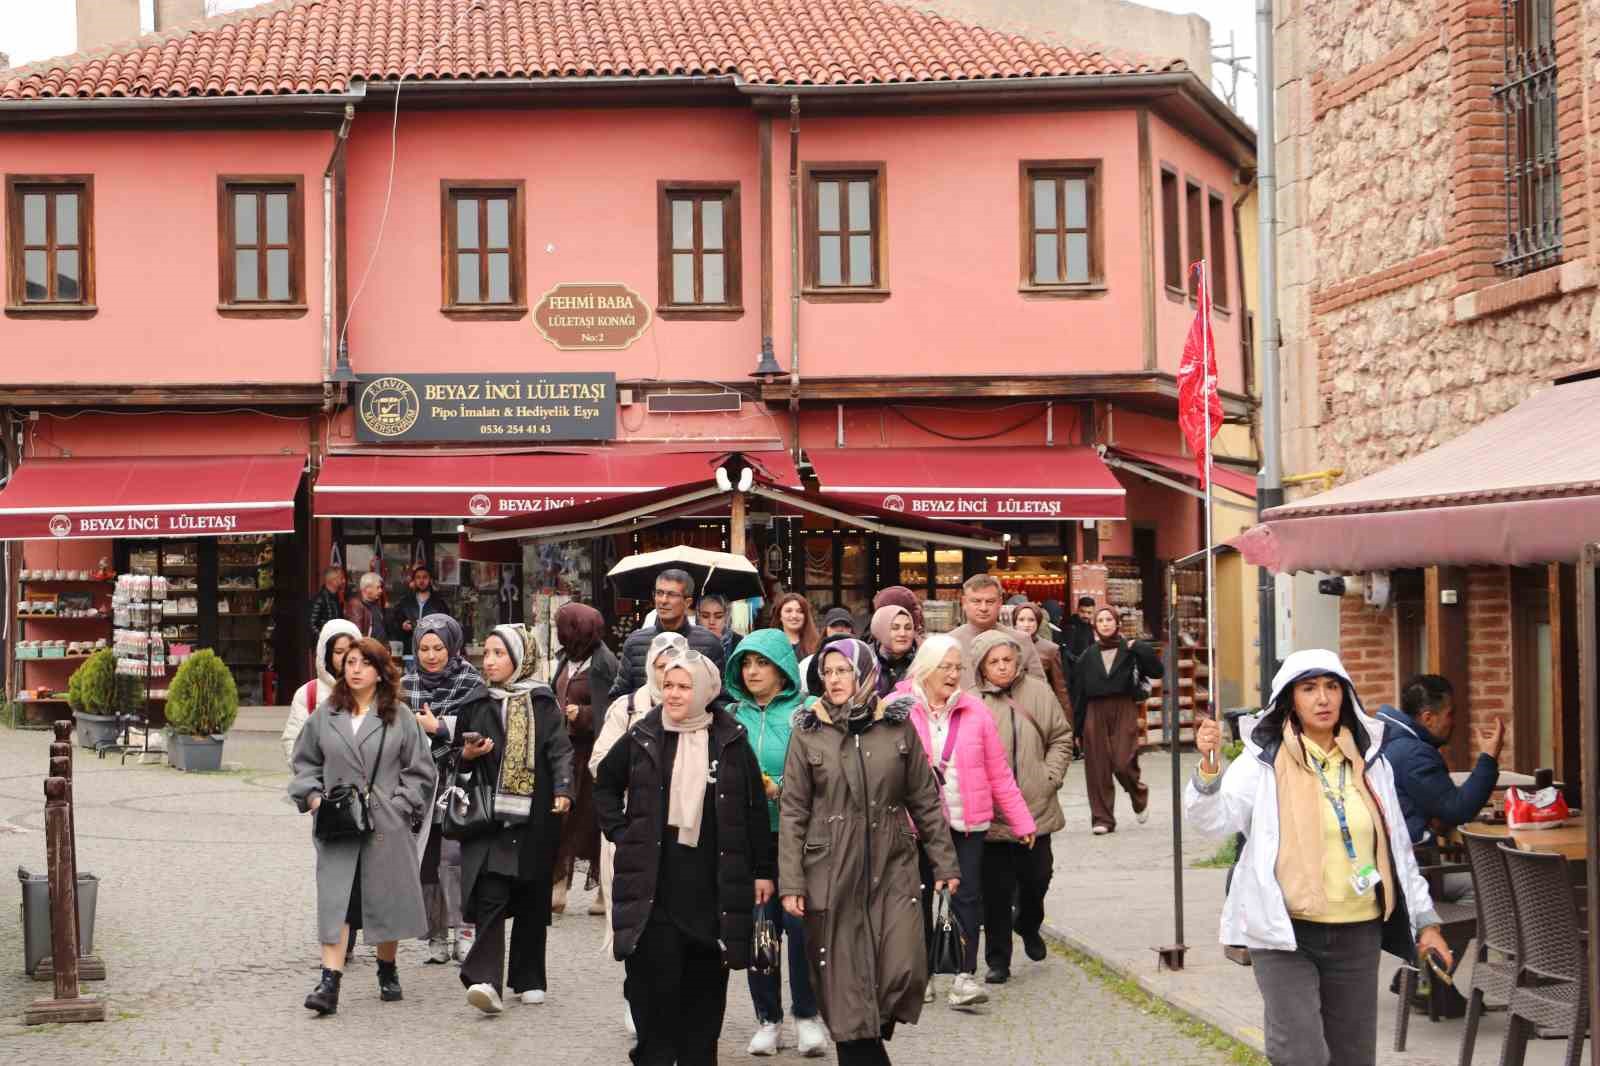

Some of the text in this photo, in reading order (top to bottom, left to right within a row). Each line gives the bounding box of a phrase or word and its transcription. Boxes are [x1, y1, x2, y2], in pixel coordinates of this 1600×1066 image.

[550, 293, 634, 309] FEHMİ BABA
[598, 313, 635, 327] KONAĞI
[425, 379, 606, 403] BEYAZ İNCİ LÜLETAŞI
[431, 404, 600, 420] Pipo İmalatı & Hediyelik Eşya
[480, 424, 552, 434] 0536 254 41 43
[499, 499, 543, 512] BEYAZ
[912, 497, 1062, 515] BEYAZ İNCİ LÜLETAŞI
[79, 513, 237, 531] BEYAZ İNCİ LÜLETAŞI
